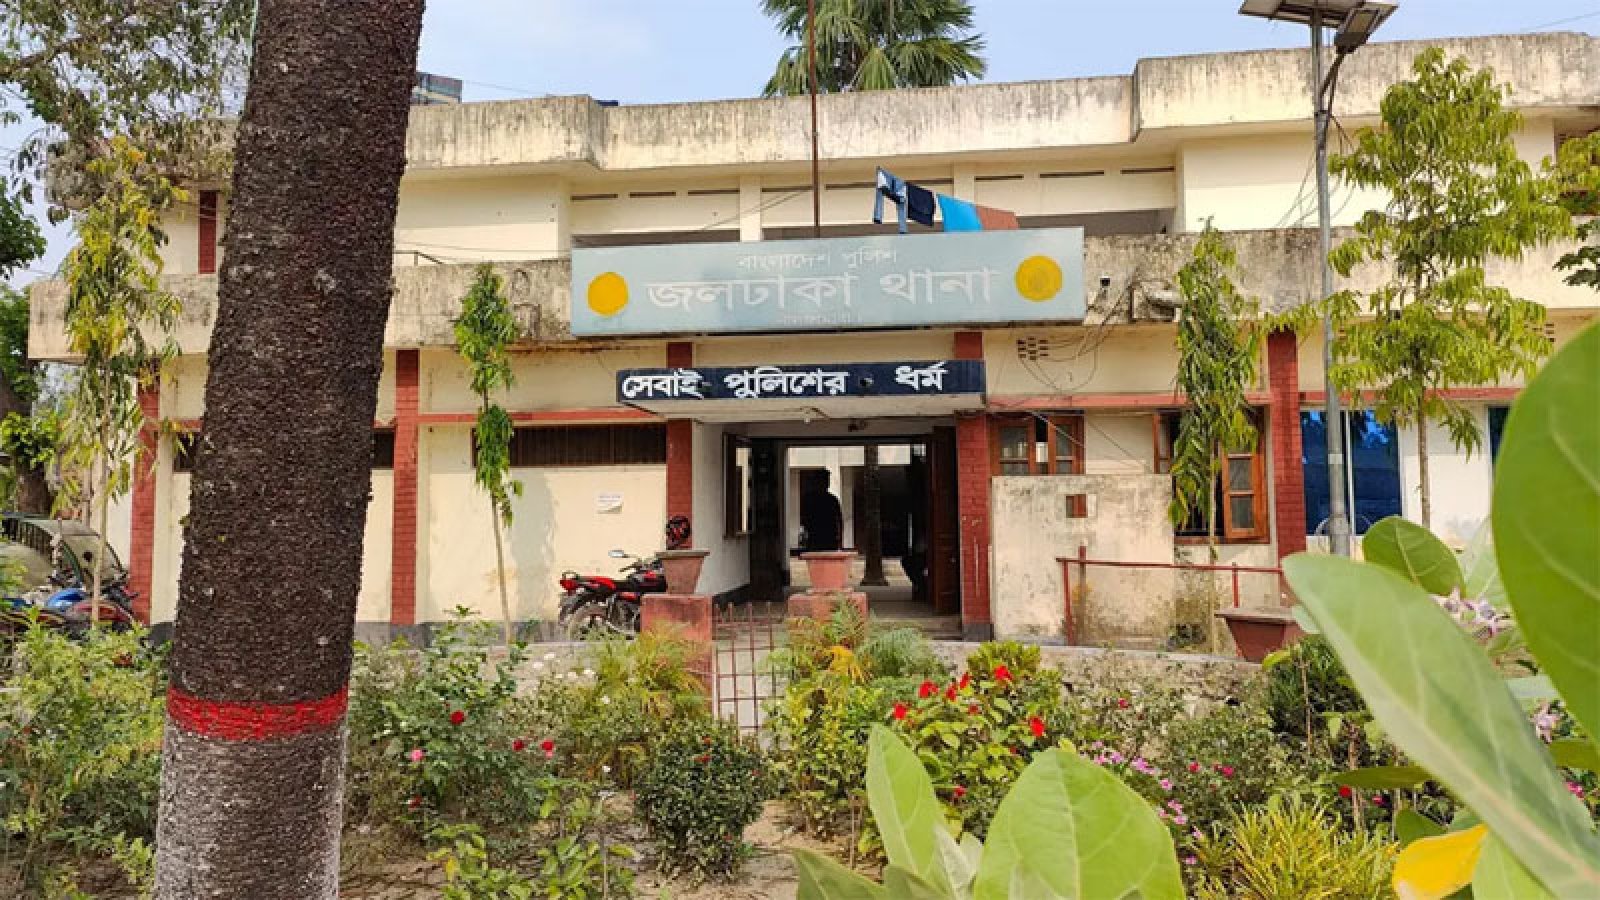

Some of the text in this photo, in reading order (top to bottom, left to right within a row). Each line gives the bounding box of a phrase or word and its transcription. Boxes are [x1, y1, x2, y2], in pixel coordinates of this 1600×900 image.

[646, 267, 1001, 312] জলঢাকা থানা
[621, 361, 948, 399] সেবাই পুলিশের ধর্ম
